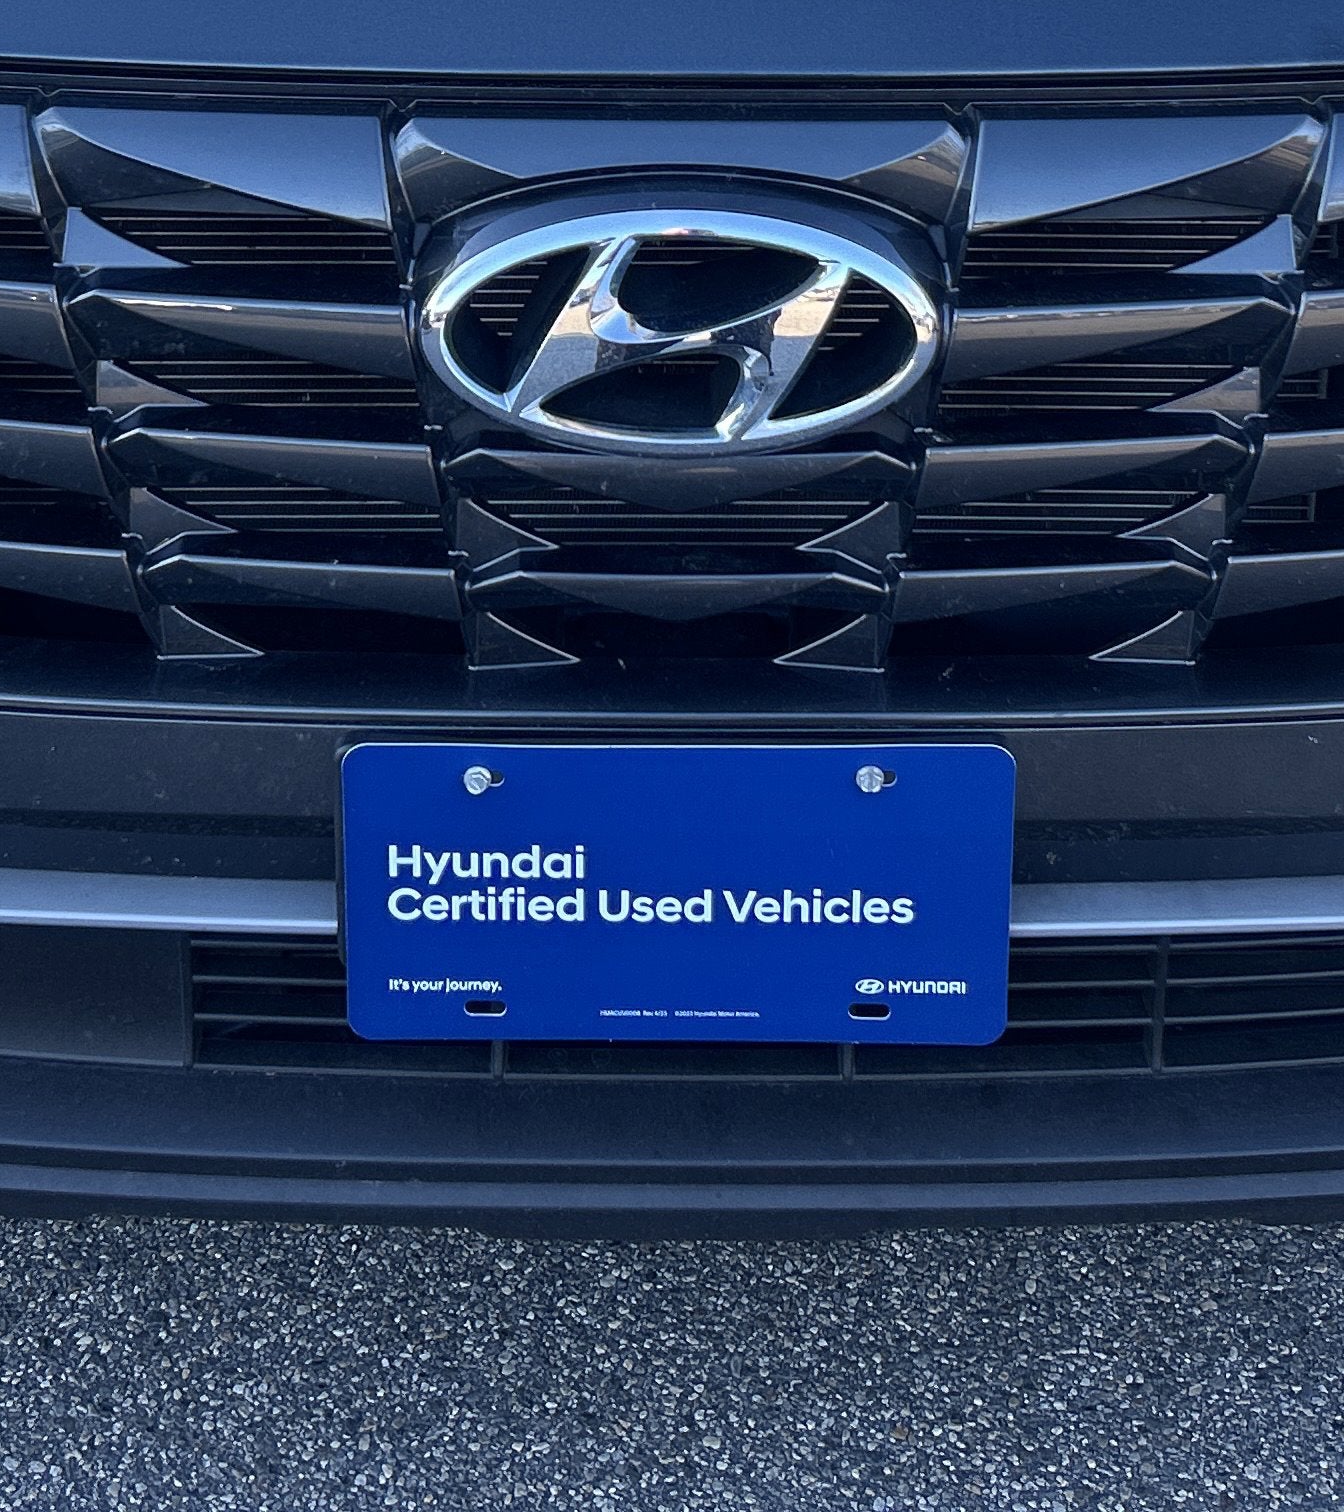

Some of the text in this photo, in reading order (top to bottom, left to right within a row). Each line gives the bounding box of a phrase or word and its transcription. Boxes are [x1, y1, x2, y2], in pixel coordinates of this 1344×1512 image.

[388, 844, 586, 885] Hyundai
[387, 886, 915, 924] Certified Used Vehicles
[412, 980, 444, 994] your
[445, 977, 503, 994] journey.
[888, 980, 967, 995] HYUNDAI
